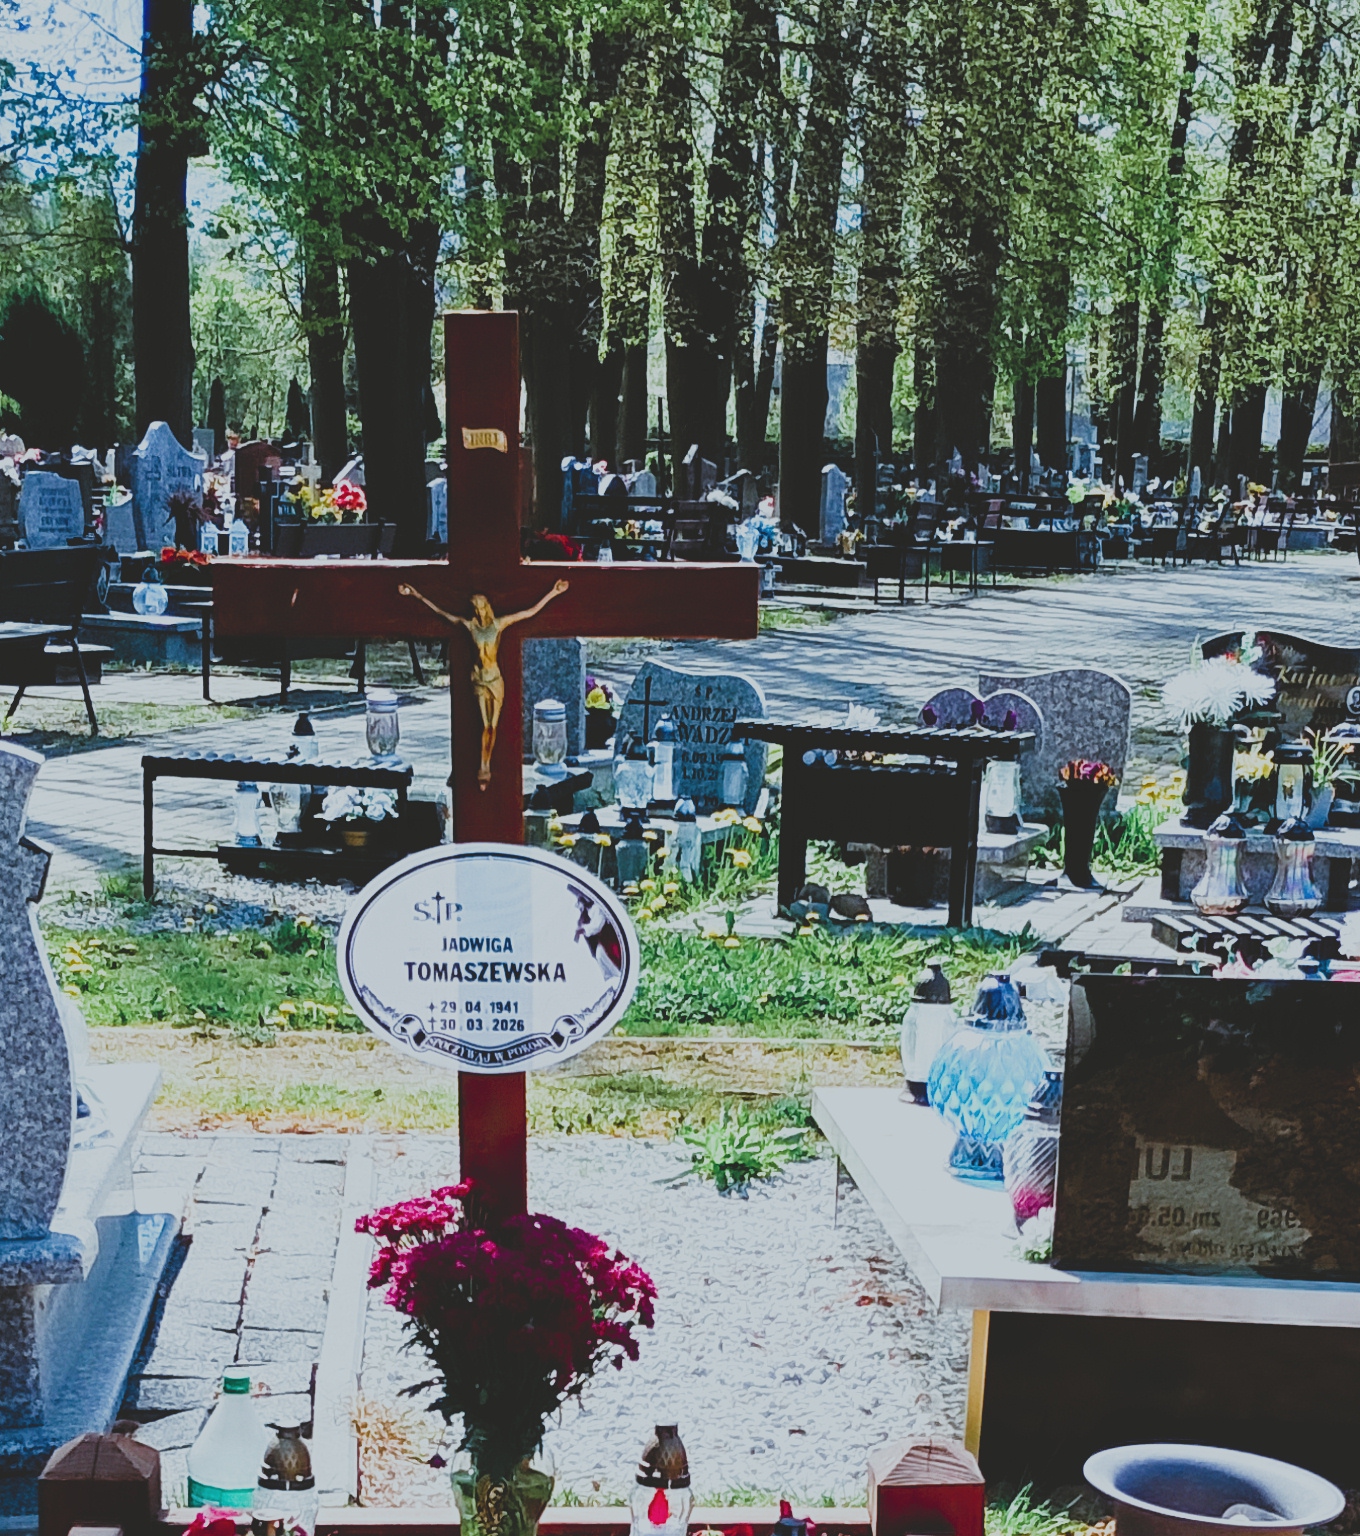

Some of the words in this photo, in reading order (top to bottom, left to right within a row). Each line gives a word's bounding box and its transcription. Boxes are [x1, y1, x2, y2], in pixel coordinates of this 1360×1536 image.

[671, 706, 738, 722] ANDRZEJ
[441, 936, 514, 953] JADWIGA
[404, 961, 567, 983] TOMASZEWSKA
